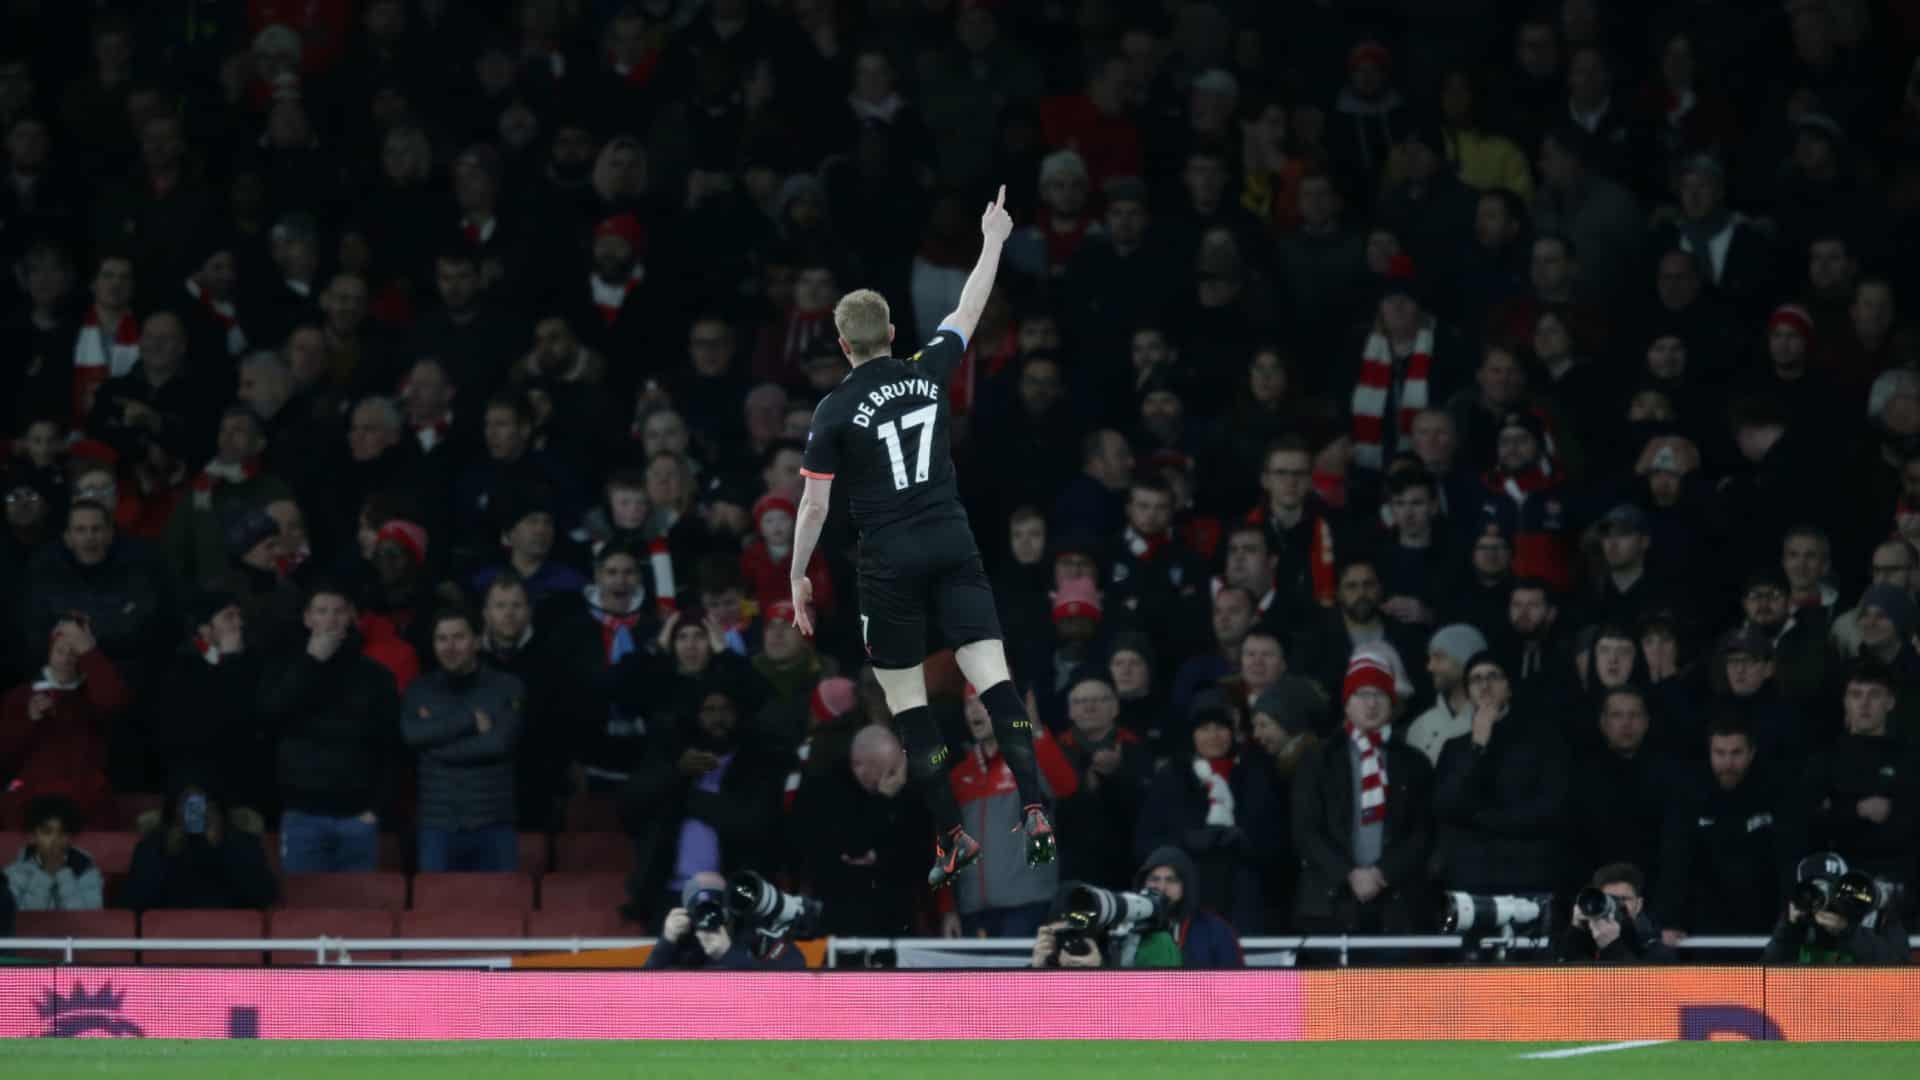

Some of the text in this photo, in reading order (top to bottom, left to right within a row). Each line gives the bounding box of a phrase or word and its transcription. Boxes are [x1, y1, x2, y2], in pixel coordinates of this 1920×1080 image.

[853, 378, 939, 428] DE BRUYNE
[876, 403, 939, 490] 17
